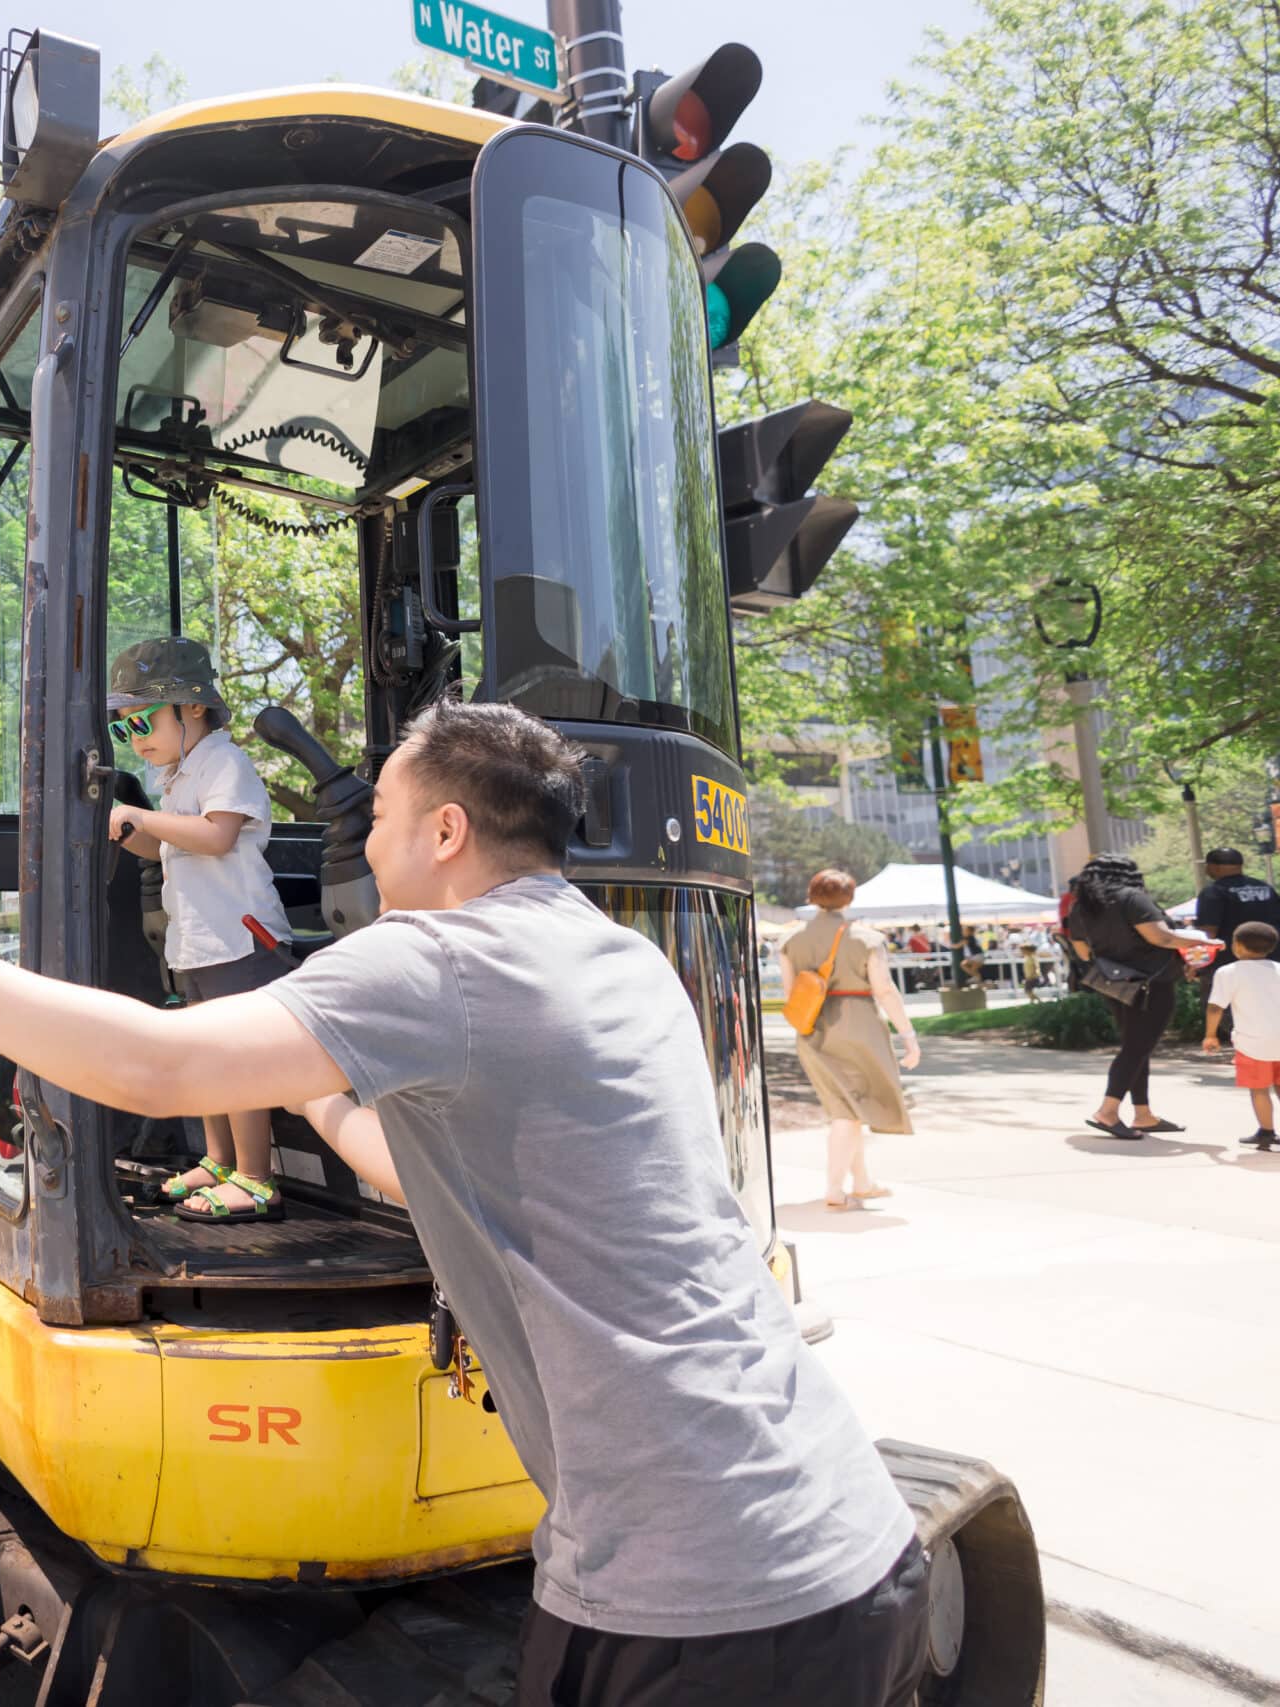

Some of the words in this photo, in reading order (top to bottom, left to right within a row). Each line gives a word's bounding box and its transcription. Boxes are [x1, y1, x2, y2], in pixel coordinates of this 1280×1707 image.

[421, 4, 431, 28] N
[439, 0, 524, 69] Water
[534, 46, 551, 71] ST
[207, 1404, 302, 1446] SR
